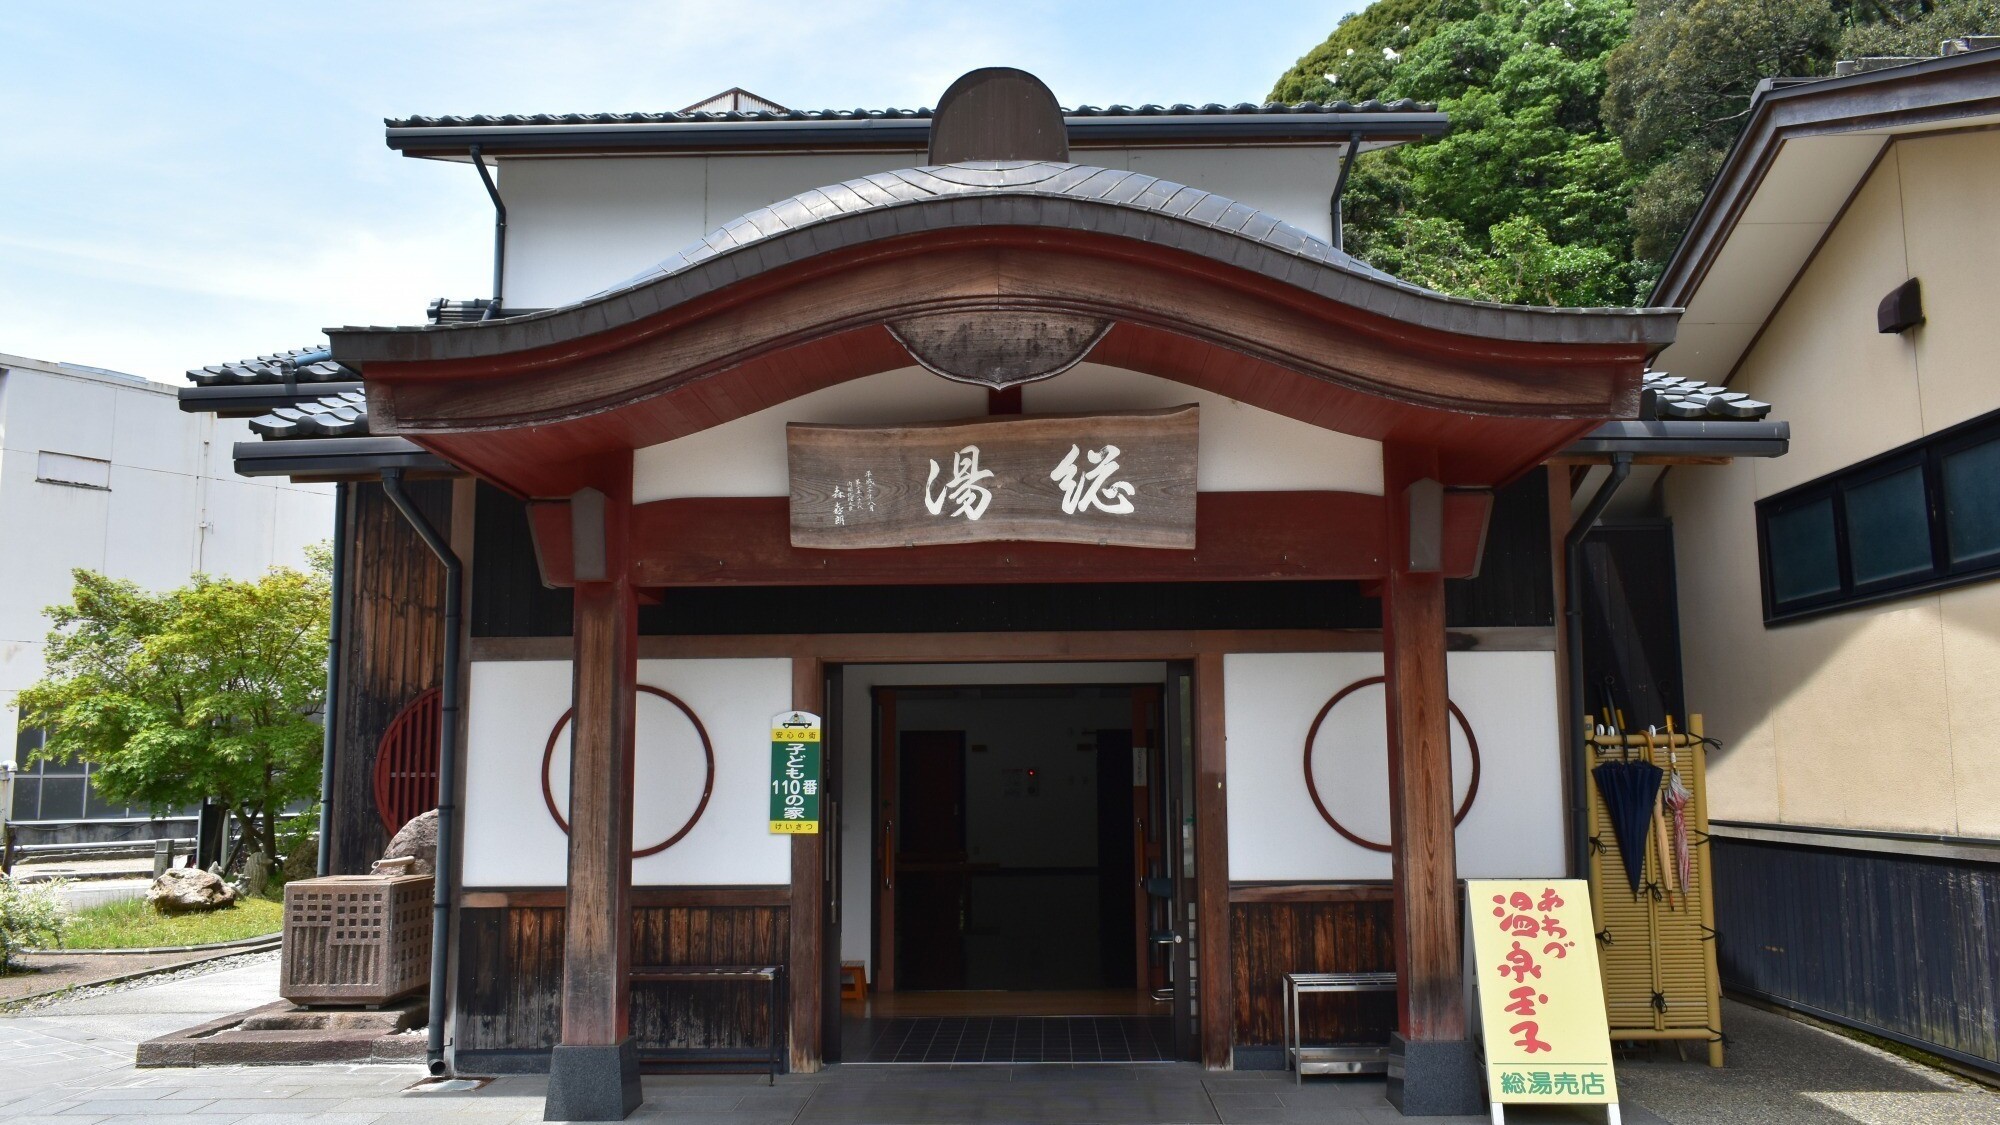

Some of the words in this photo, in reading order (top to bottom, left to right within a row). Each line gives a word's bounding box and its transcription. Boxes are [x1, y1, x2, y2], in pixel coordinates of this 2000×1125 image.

[775, 731, 816, 739] 安心の街
[775, 822, 813, 830] けいさつ
[1537, 887, 1575, 958] あわづ
[1493, 891, 1552, 1053] 温泉玉子
[1500, 1071, 1605, 1096] 総湯売店
